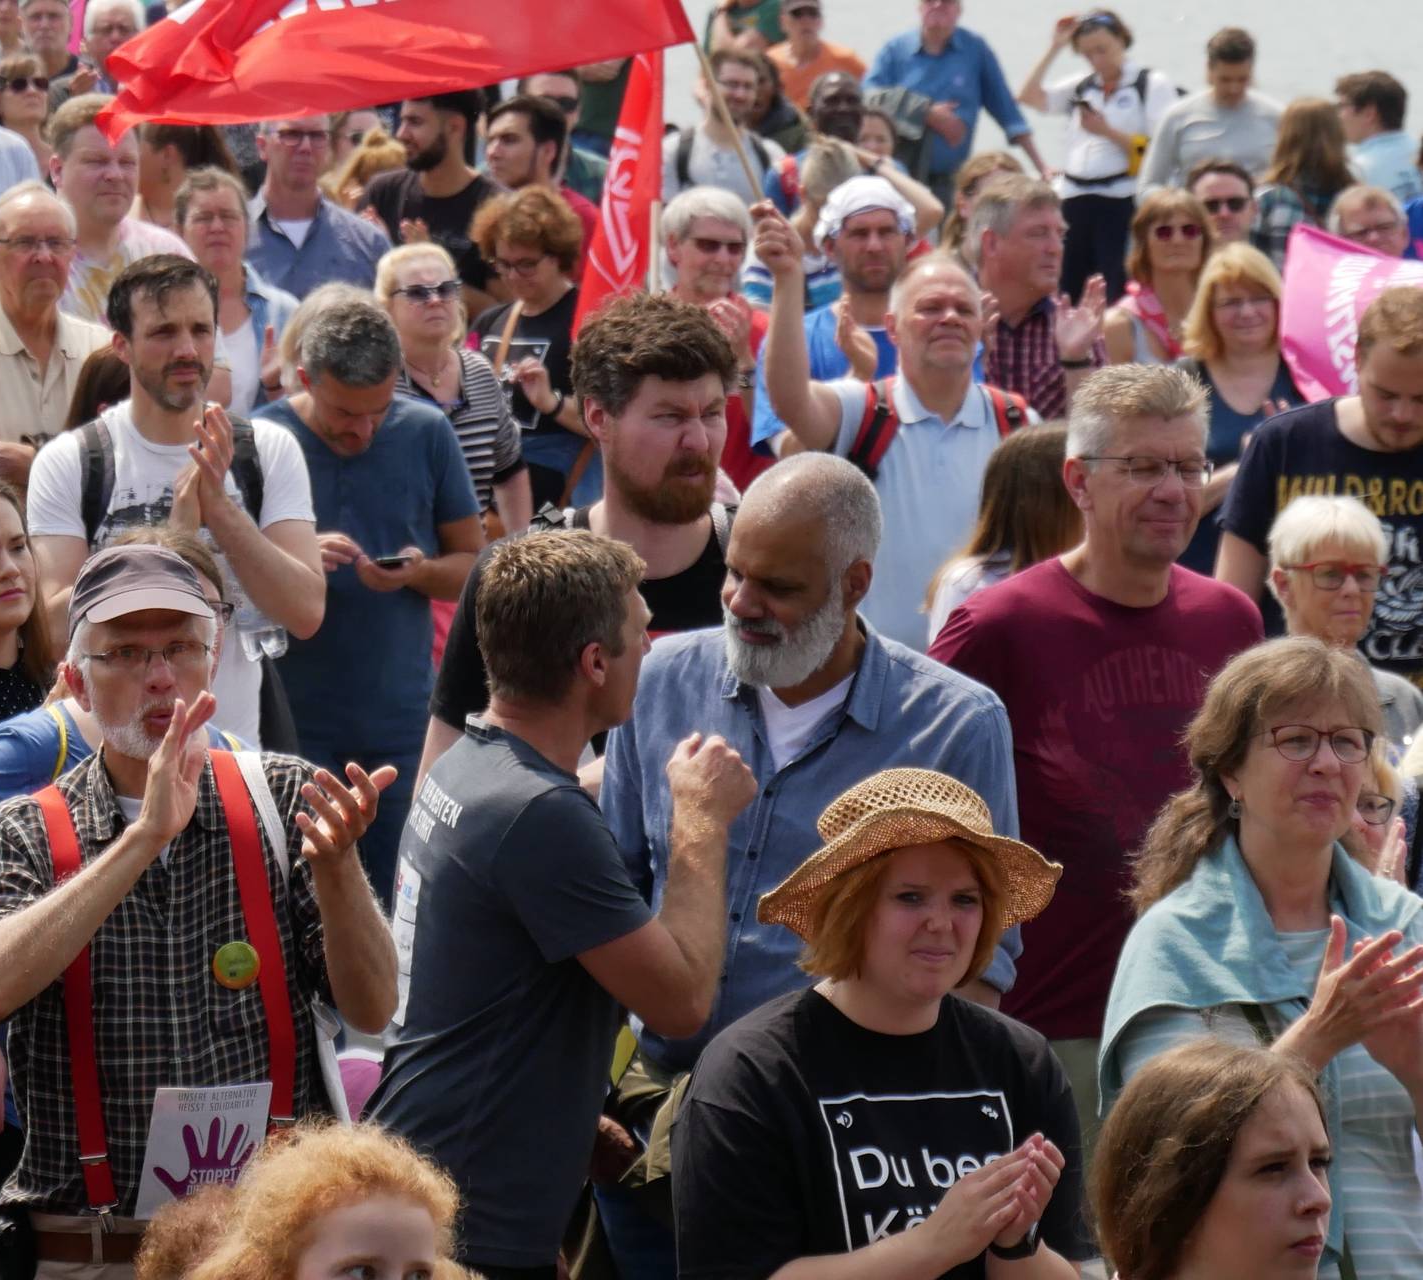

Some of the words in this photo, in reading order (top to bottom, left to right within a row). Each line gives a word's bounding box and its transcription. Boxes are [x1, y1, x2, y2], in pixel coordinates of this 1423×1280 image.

[211, 1088, 257, 1100] ALTERNATIVE
[189, 1167, 238, 1185] STOPPT
[849, 1148, 915, 1189] Du
